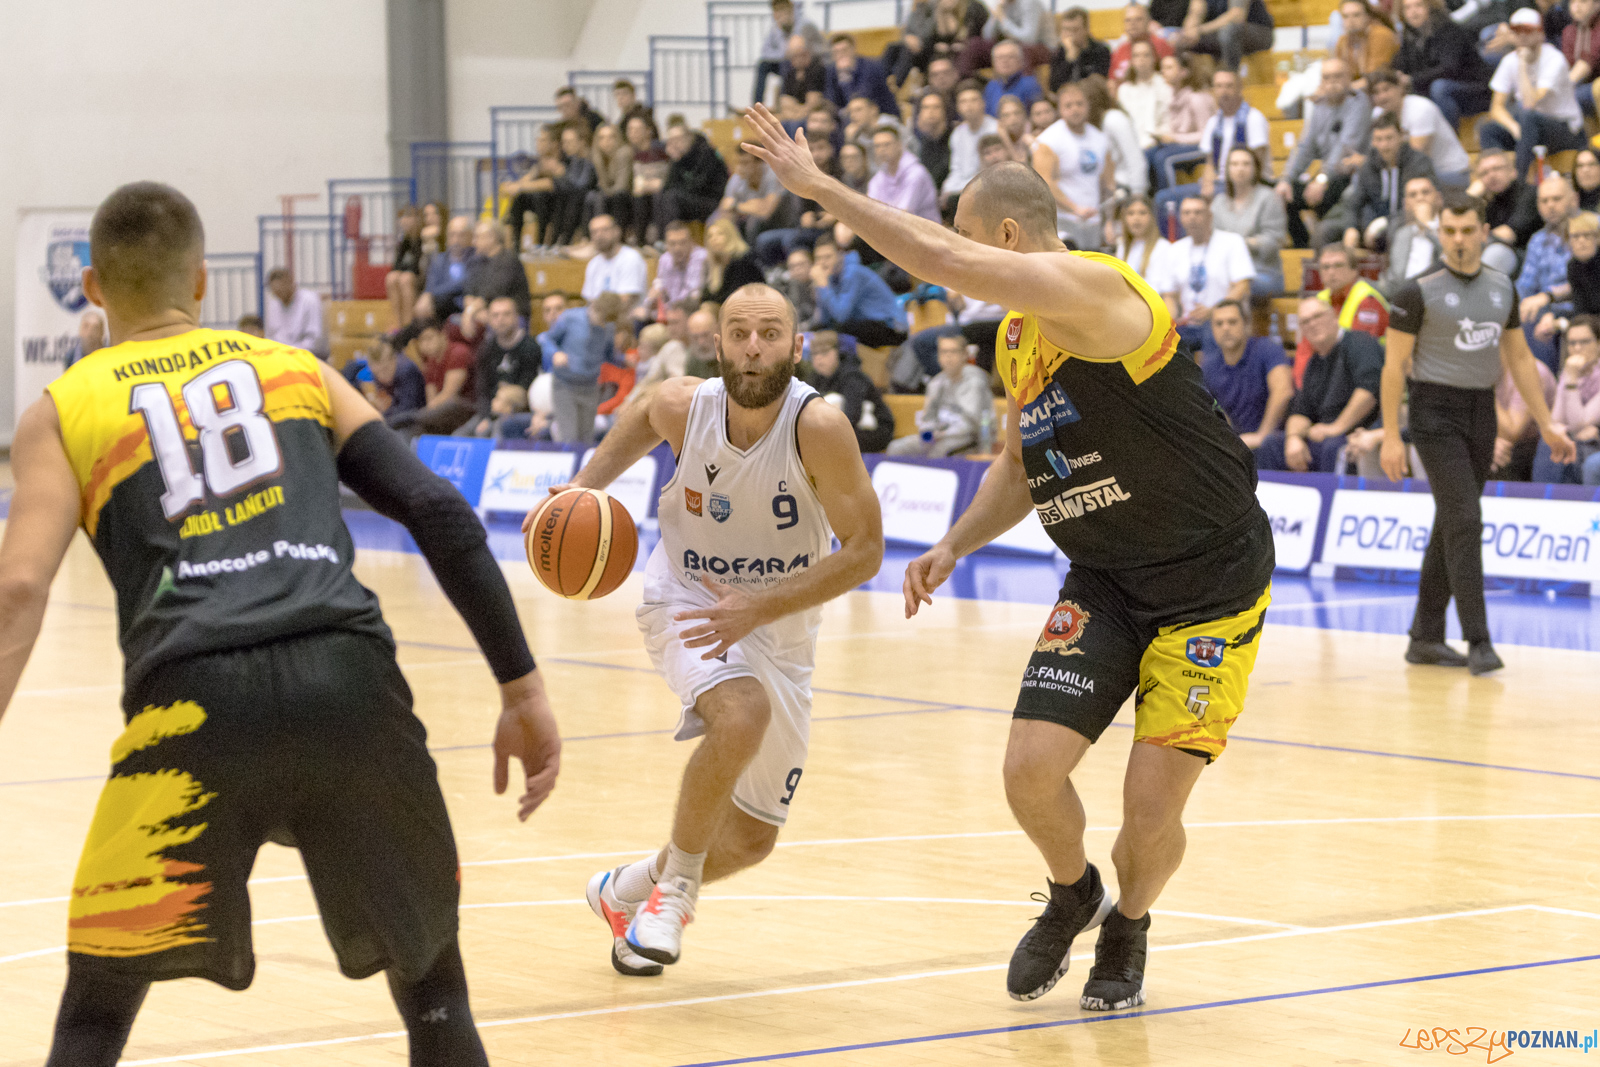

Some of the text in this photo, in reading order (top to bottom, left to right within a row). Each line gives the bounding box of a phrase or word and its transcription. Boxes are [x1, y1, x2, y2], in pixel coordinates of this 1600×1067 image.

[128, 357, 285, 523] 18
[1020, 424, 1051, 441] ańcucka
[1068, 451, 1103, 470] TOWERS
[778, 480, 787, 493] C
[771, 493, 799, 531] 9
[541, 506, 564, 572] molten
[1337, 514, 1431, 552] POZna
[683, 548, 810, 577] BIOFARM
[1038, 680, 1083, 698] MEDYCZNY
[1185, 684, 1210, 721] 6
[780, 766, 803, 806] 9
